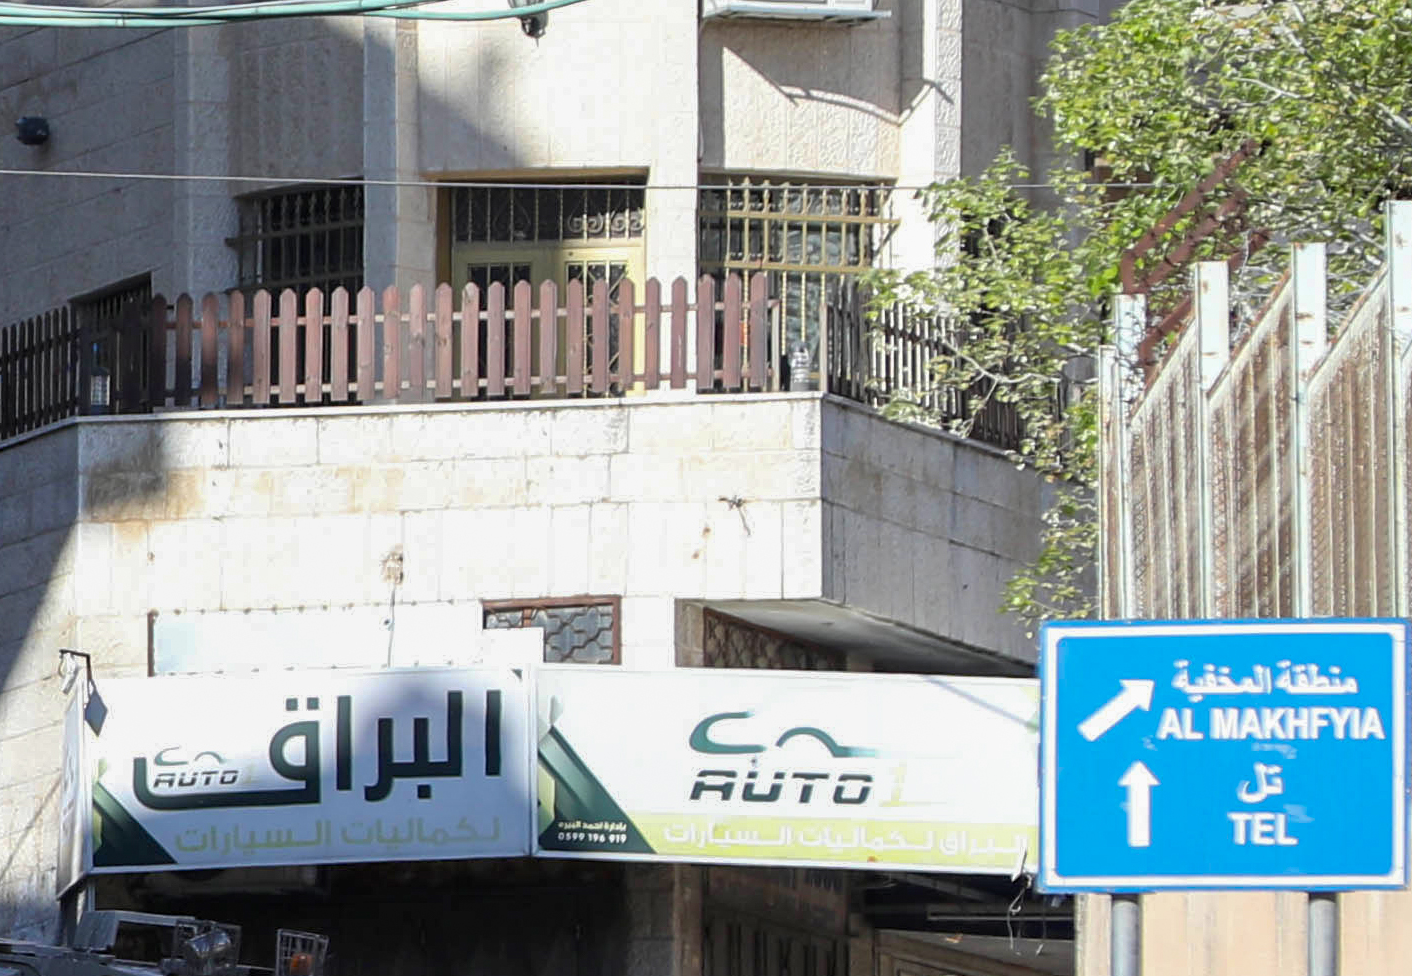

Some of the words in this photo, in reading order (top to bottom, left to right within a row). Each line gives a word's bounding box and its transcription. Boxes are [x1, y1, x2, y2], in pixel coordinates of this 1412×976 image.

[1171, 659, 1272, 702] المخفية
[1276, 659, 1359, 694] منطقة
[1156, 707, 1204, 740] AL
[1210, 707, 1386, 740] MAKHFYIA
[133, 689, 502, 811] البراق
[153, 770, 242, 789] AUTO
[689, 769, 875, 805] AUTO
[1237, 762, 1284, 803] تل
[1227, 812, 1298, 845] TEL
